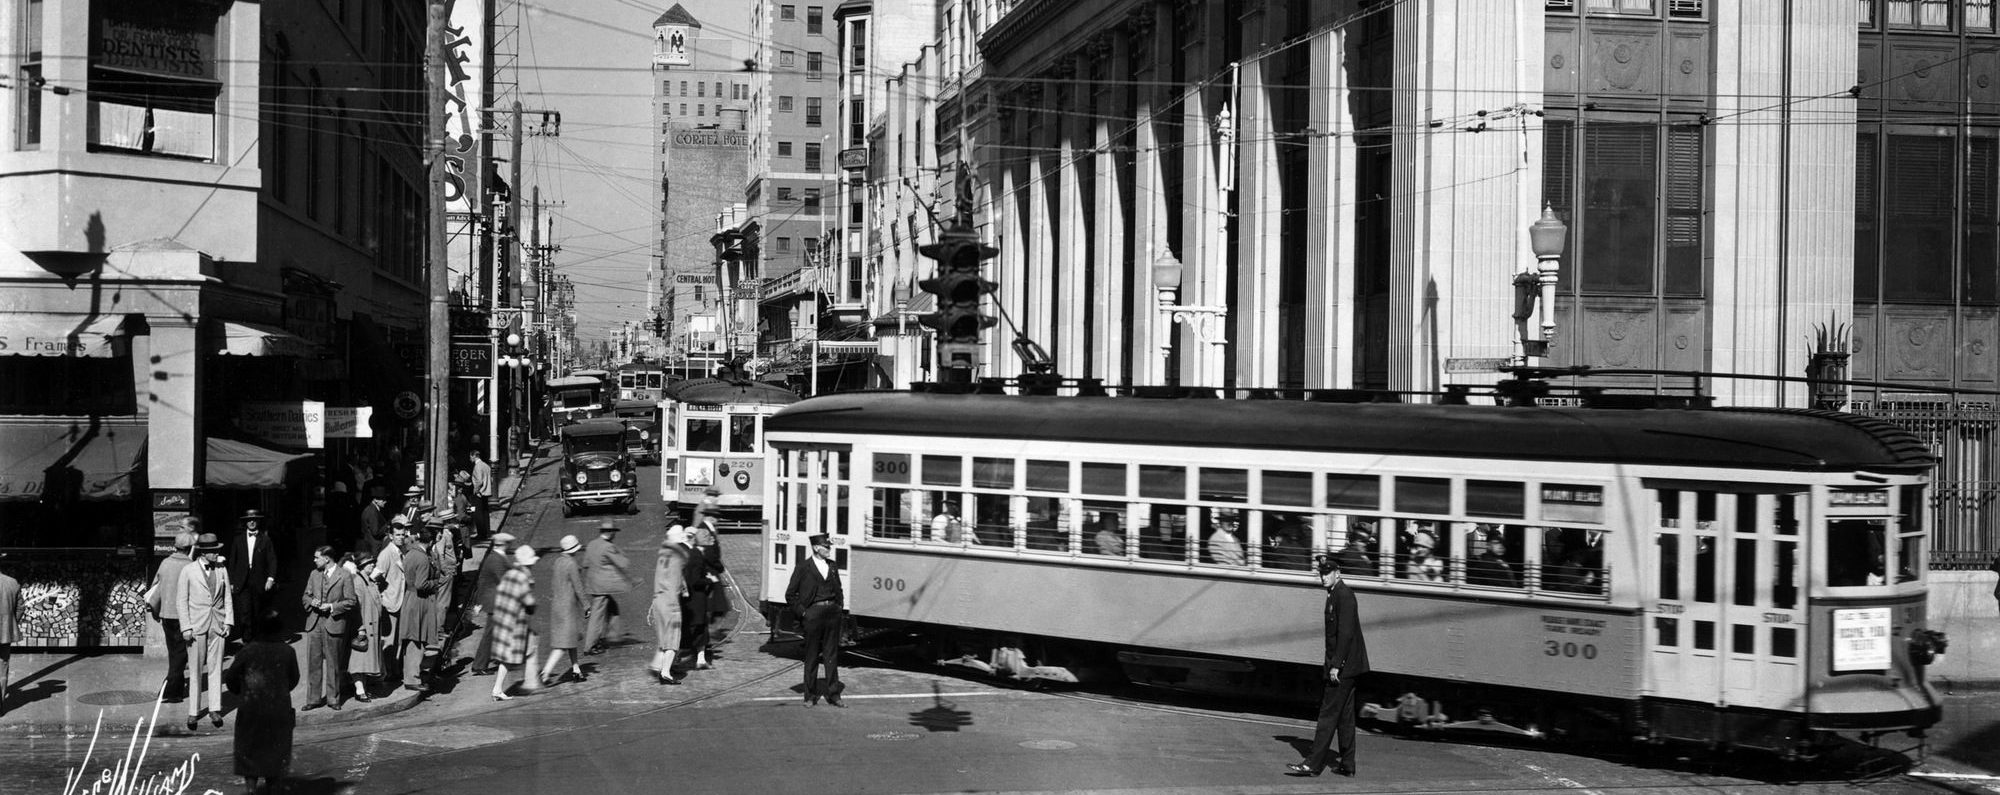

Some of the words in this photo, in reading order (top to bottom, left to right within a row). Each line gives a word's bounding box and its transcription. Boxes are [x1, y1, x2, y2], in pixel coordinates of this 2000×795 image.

[103, 38, 200, 60] DENTISTS
[675, 134, 718, 146] CORTEZ
[723, 135, 748, 146] HOTE
[676, 274, 702, 284] CENTRAL
[703, 275, 715, 284] HOT
[25, 336, 87, 352] Frames
[246, 410, 286, 423] Southern
[288, 409, 319, 423] Dairies
[325, 408, 349, 417] FRESH
[731, 461, 754, 469] 220
[874, 460, 908, 474] 300
[1543, 489, 1573, 501] MIAMI
[1575, 491, 1602, 503] BEACH
[776, 533, 791, 541] STOP
[831, 537, 846, 545] STOP
[872, 576, 906, 591] 300
[1656, 603, 1685, 614] STOP
[1762, 612, 1792, 623] STOP
[1543, 639, 1598, 660] 300
